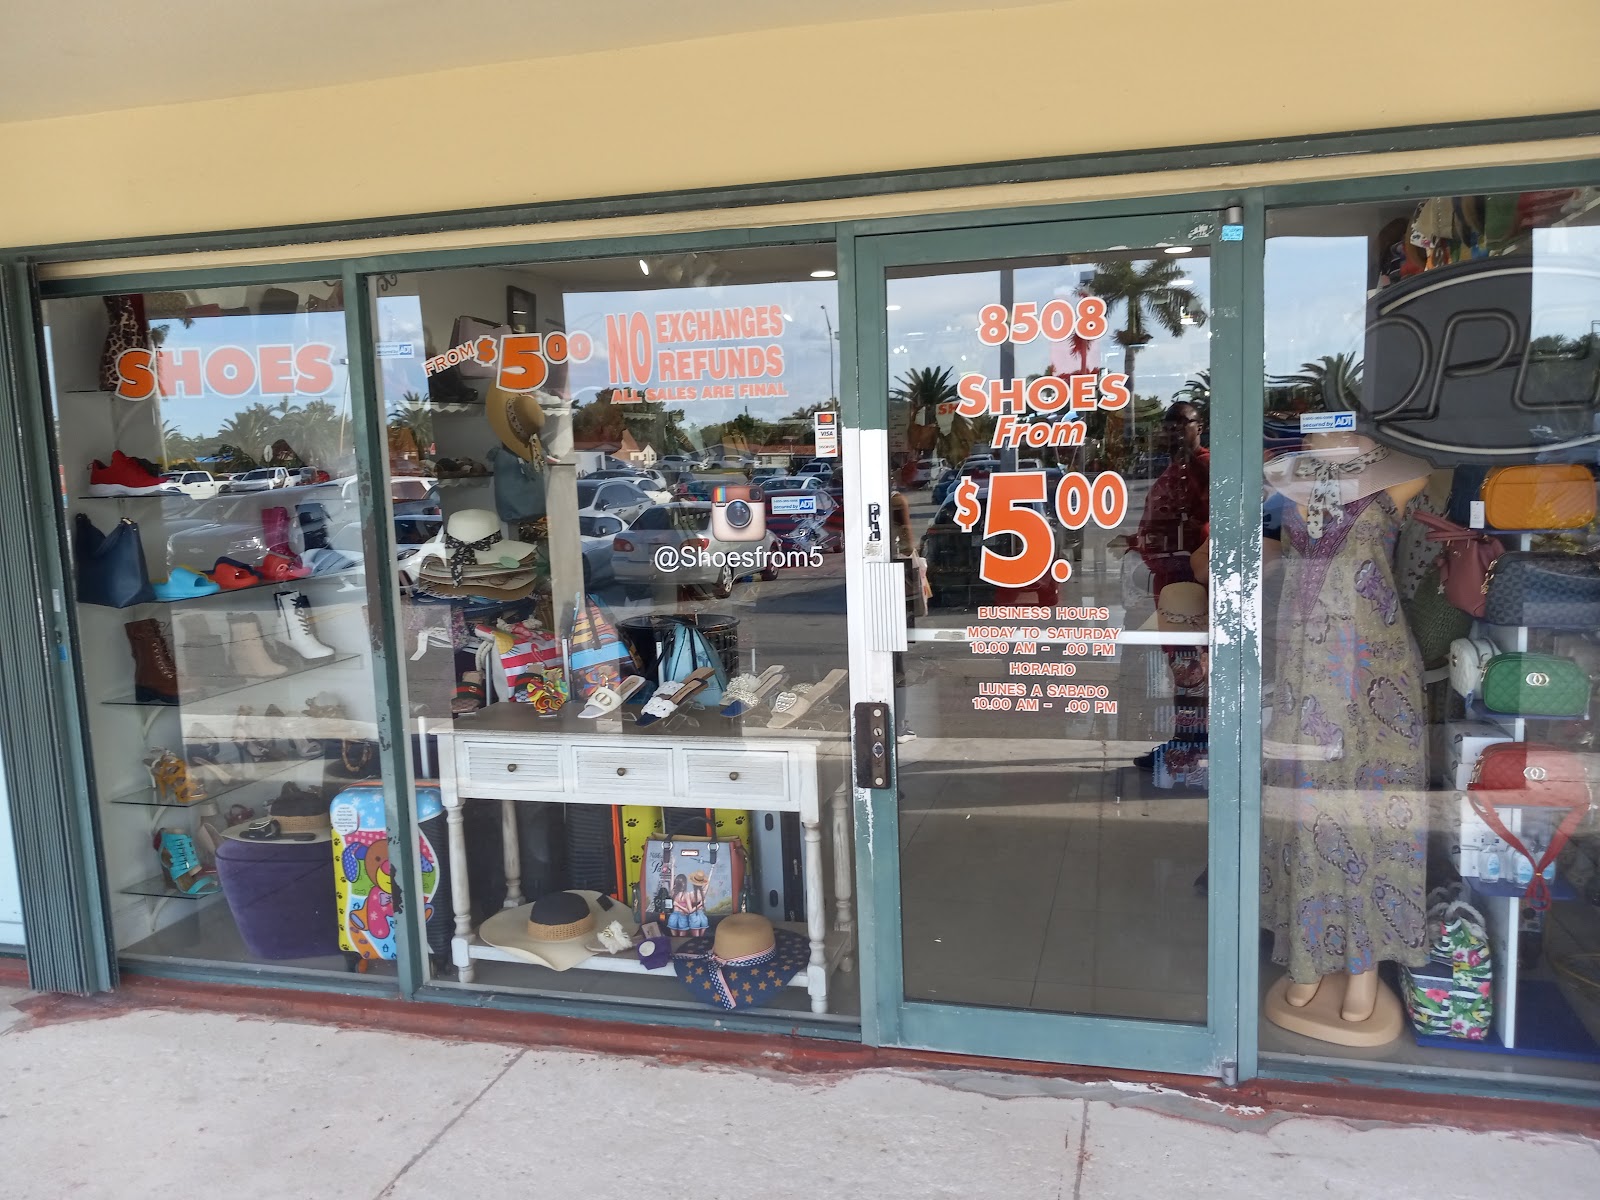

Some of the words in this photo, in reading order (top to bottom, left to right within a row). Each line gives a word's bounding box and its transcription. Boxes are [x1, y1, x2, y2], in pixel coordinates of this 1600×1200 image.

[655, 304, 785, 344] EXCHANGES
[977, 296, 1108, 346] 8508
[421, 340, 475, 378] FROM
[605, 311, 654, 386] NO
[657, 343, 786, 382] REFUNDS
[114, 342, 336, 401] SHOES
[610, 388, 643, 405] ALL
[644, 385, 698, 403] SALES
[701, 384, 736, 400] ARE
[738, 382, 789, 399] FINAL
[955, 372, 1131, 418] SHOES
[991, 415, 1087, 448] From
[1335, 415, 1353, 428] ADT
[799, 499, 814, 510] ADT
[869, 503, 881, 541] PULL
[654, 545, 824, 573] @Shoesfrom5
[977, 606, 1051, 619] BUSINESS
[1055, 606, 1109, 619] HOURS
[966, 626, 1016, 638] MODAY
[1020, 627, 1041, 639] TO
[1047, 627, 1122, 640] SATURDAY
[970, 641, 1009, 654] 10.00
[1013, 642, 1037, 654] AM
[1092, 643, 1116, 656] PM
[1009, 662, 1076, 676] HORARIO
[978, 683, 1026, 695] LUNES
[1030, 684, 1043, 697] A
[1047, 685, 1109, 698] SABADO
[972, 697, 1011, 710] 10.00
[1015, 698, 1039, 711] AM
[1094, 701, 1118, 714] PM
